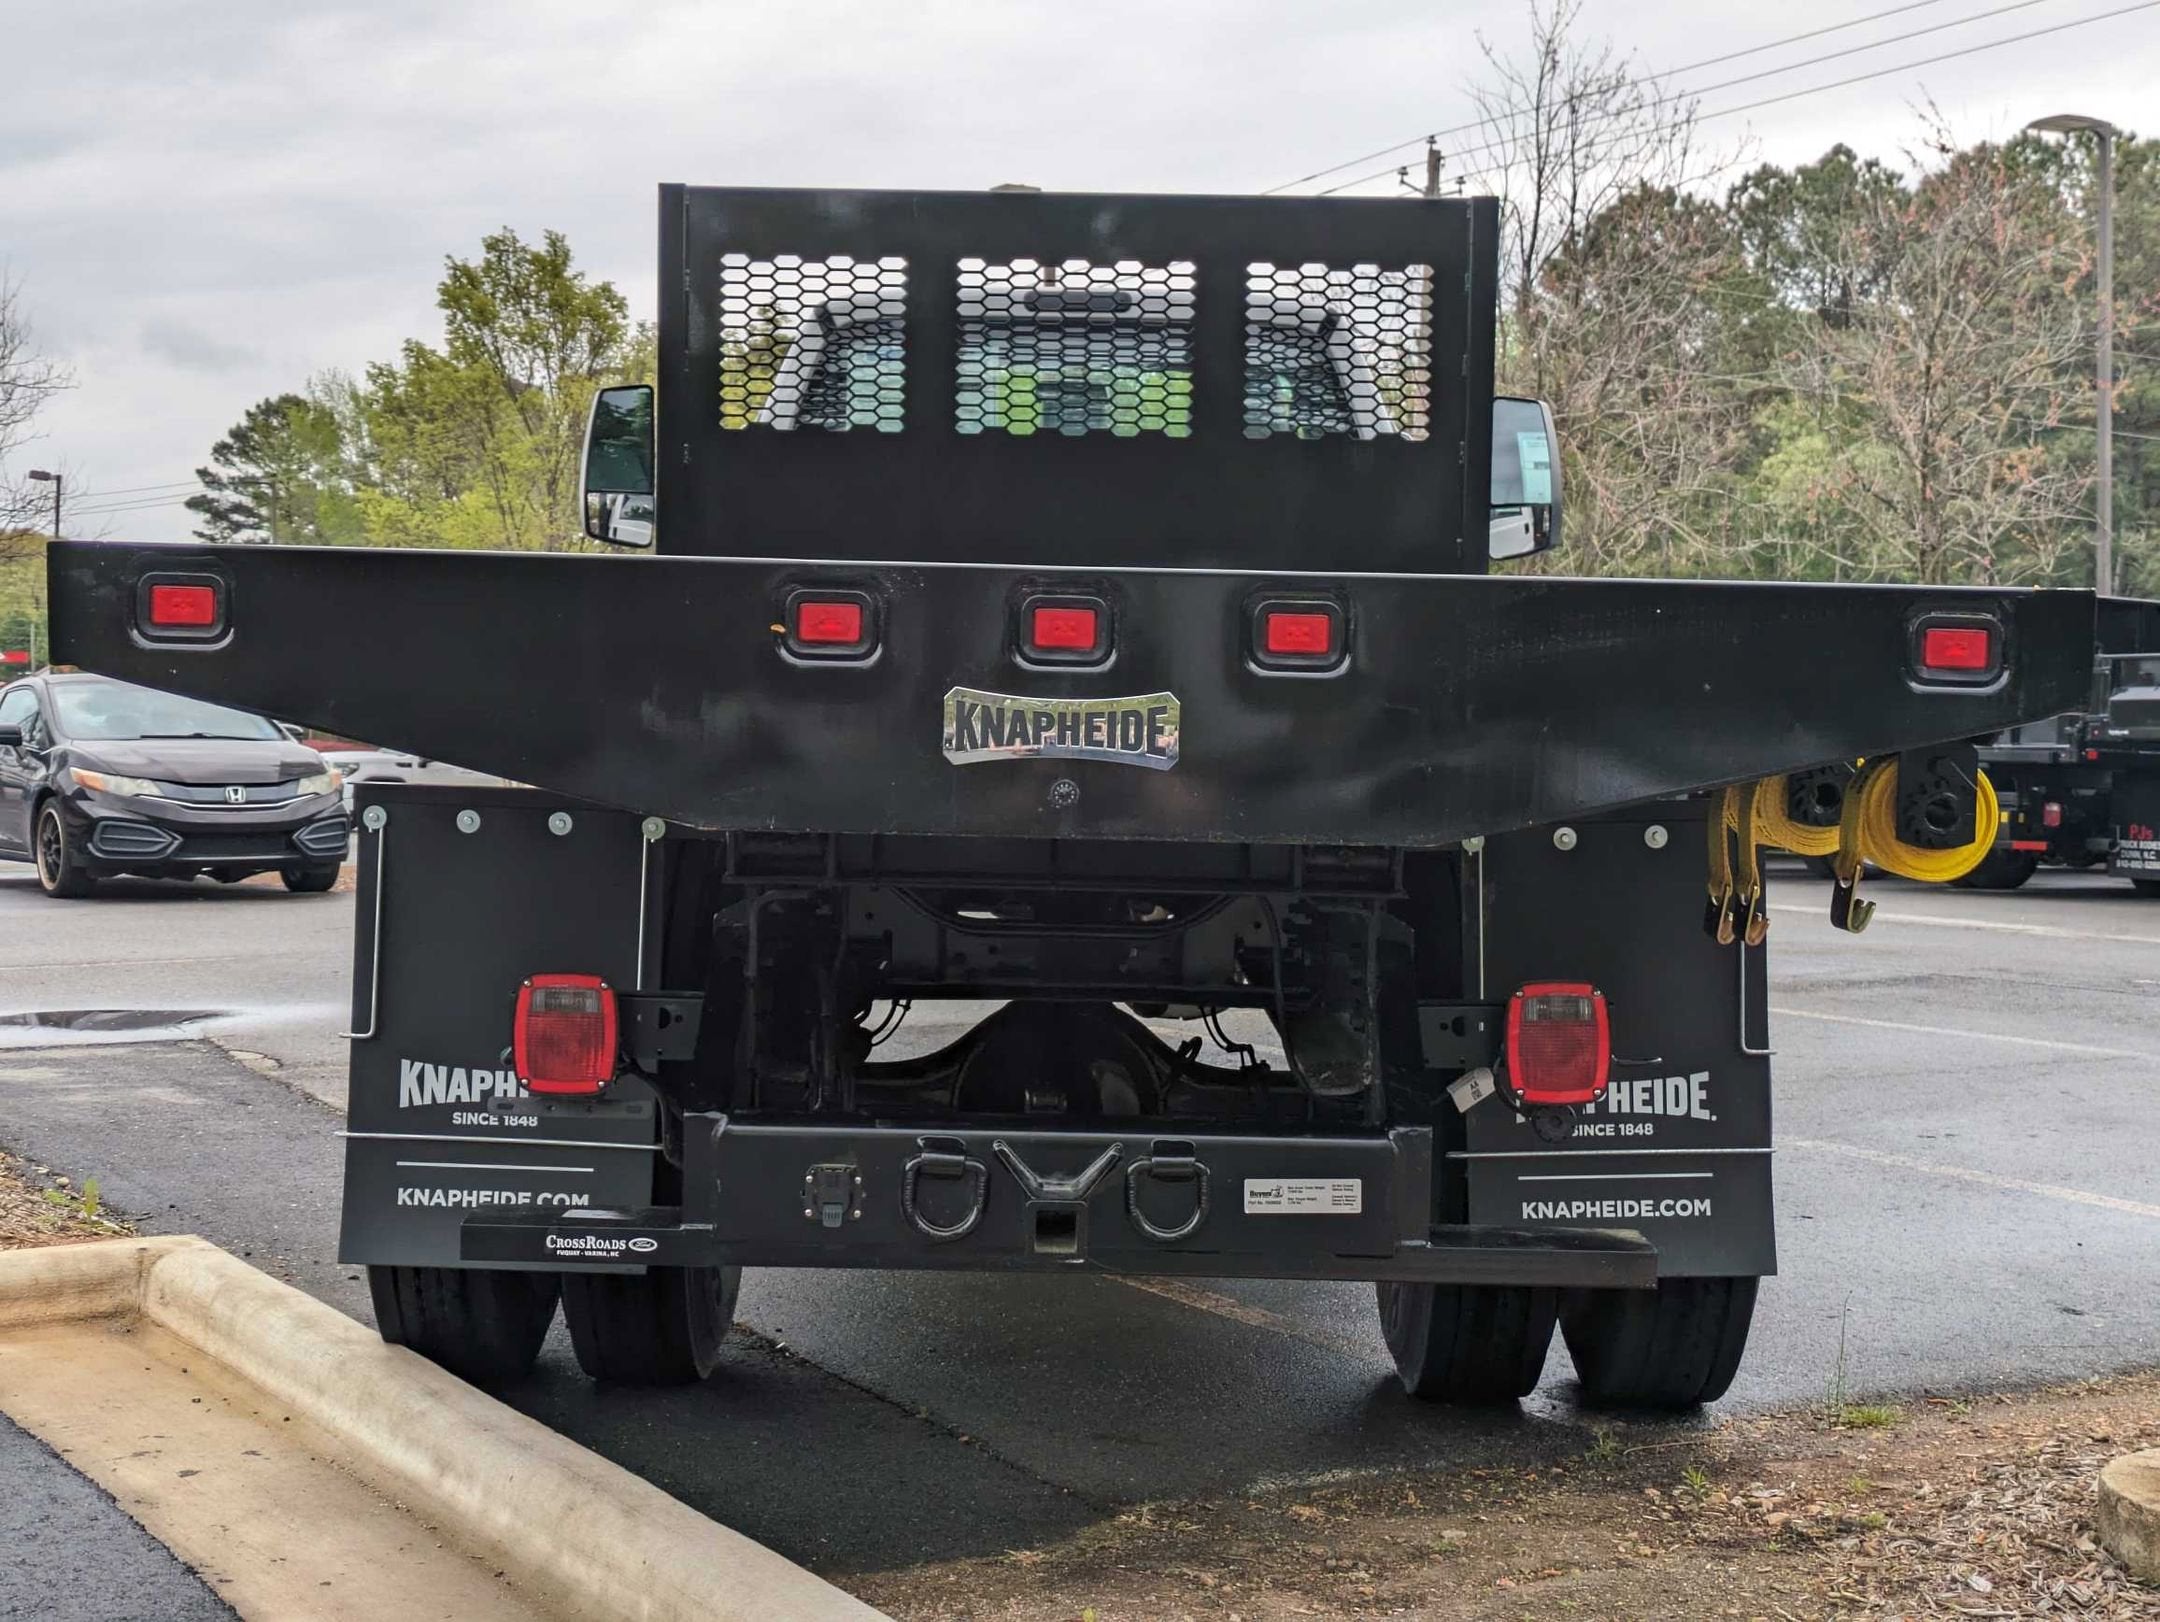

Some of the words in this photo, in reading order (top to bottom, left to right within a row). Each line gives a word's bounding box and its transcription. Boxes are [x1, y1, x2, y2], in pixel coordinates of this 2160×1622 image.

[954, 699, 1168, 758] KNAPHEIDE
[400, 1058, 529, 1108] KNAPH
[452, 1111, 499, 1126] SINCE
[503, 1115, 538, 1127] 1848
[1619, 1122, 1654, 1137] 1848
[397, 1187, 589, 1208] KNAPHEIDECOM
[1522, 1198, 1712, 1220] KNAPHEIDE.COM
